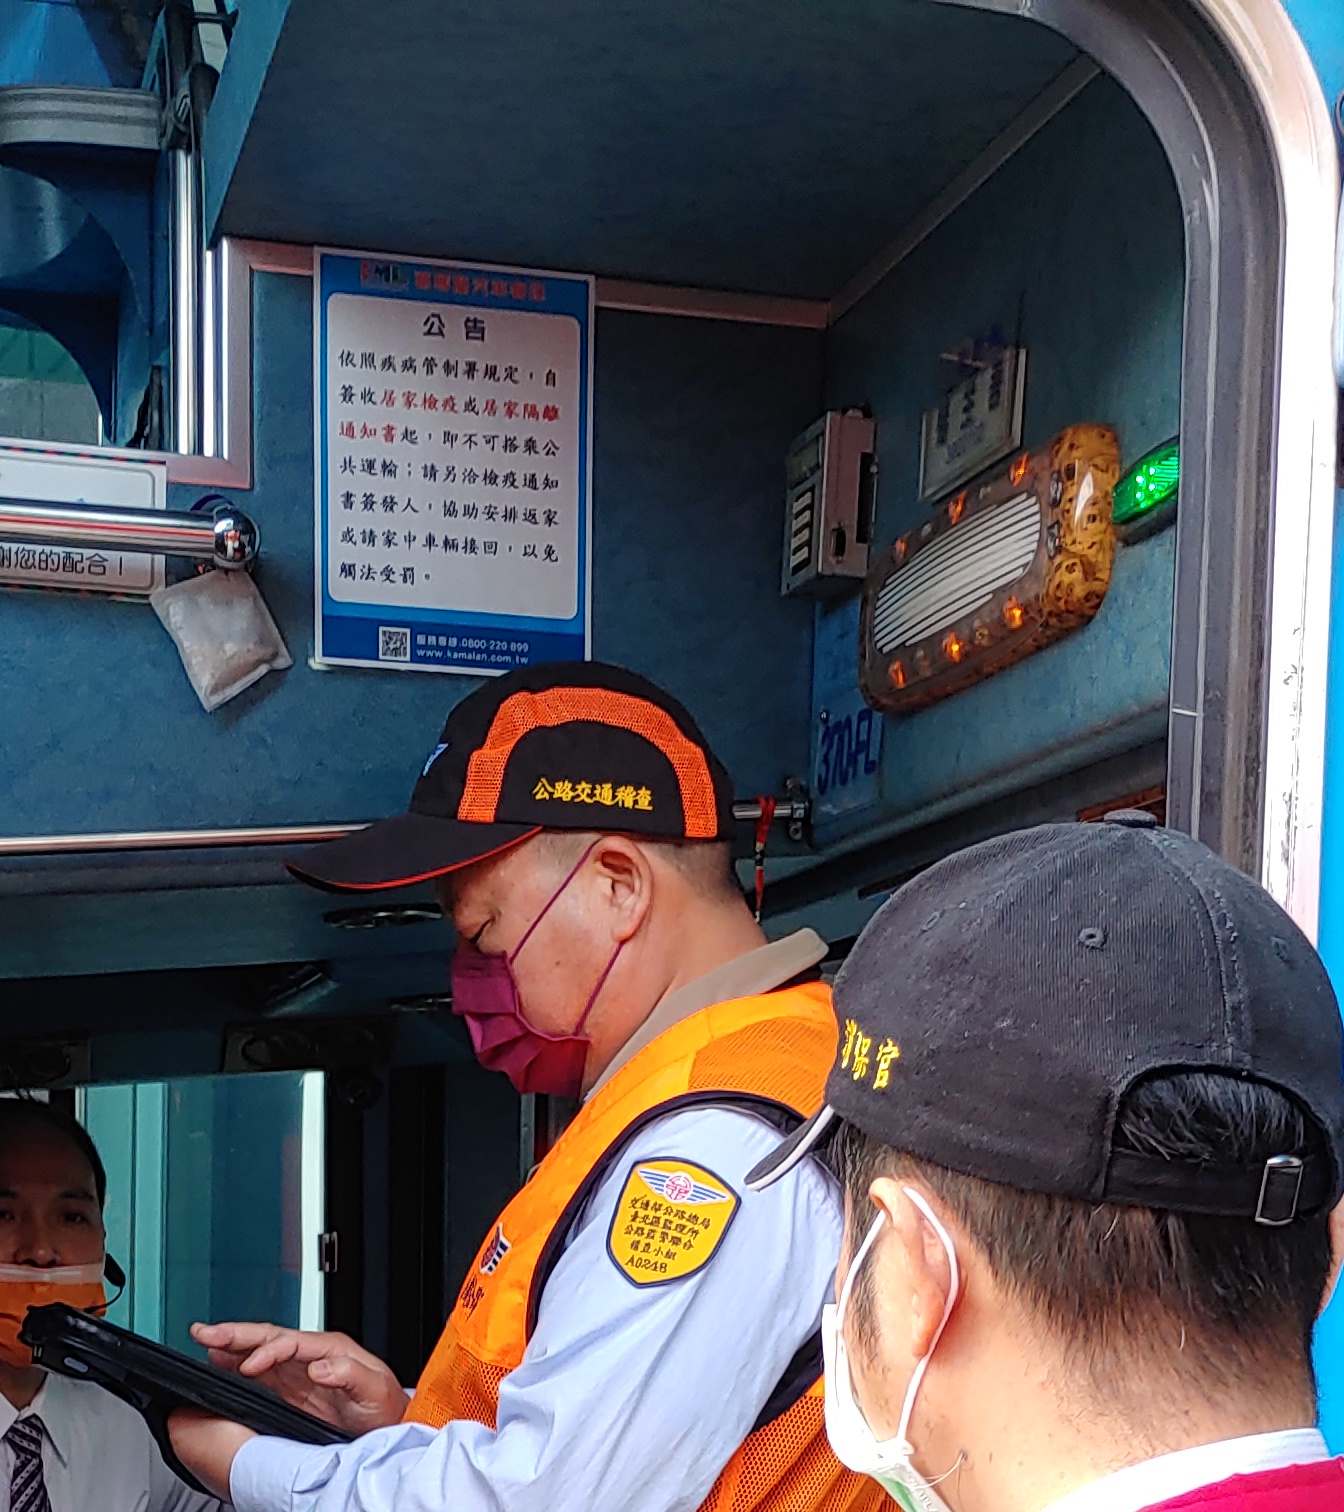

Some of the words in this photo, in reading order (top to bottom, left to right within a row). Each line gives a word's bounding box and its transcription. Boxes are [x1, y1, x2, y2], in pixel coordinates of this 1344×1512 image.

[422, 312, 487, 343] 公告
[532, 776, 654, 811] 公路交通稽查
